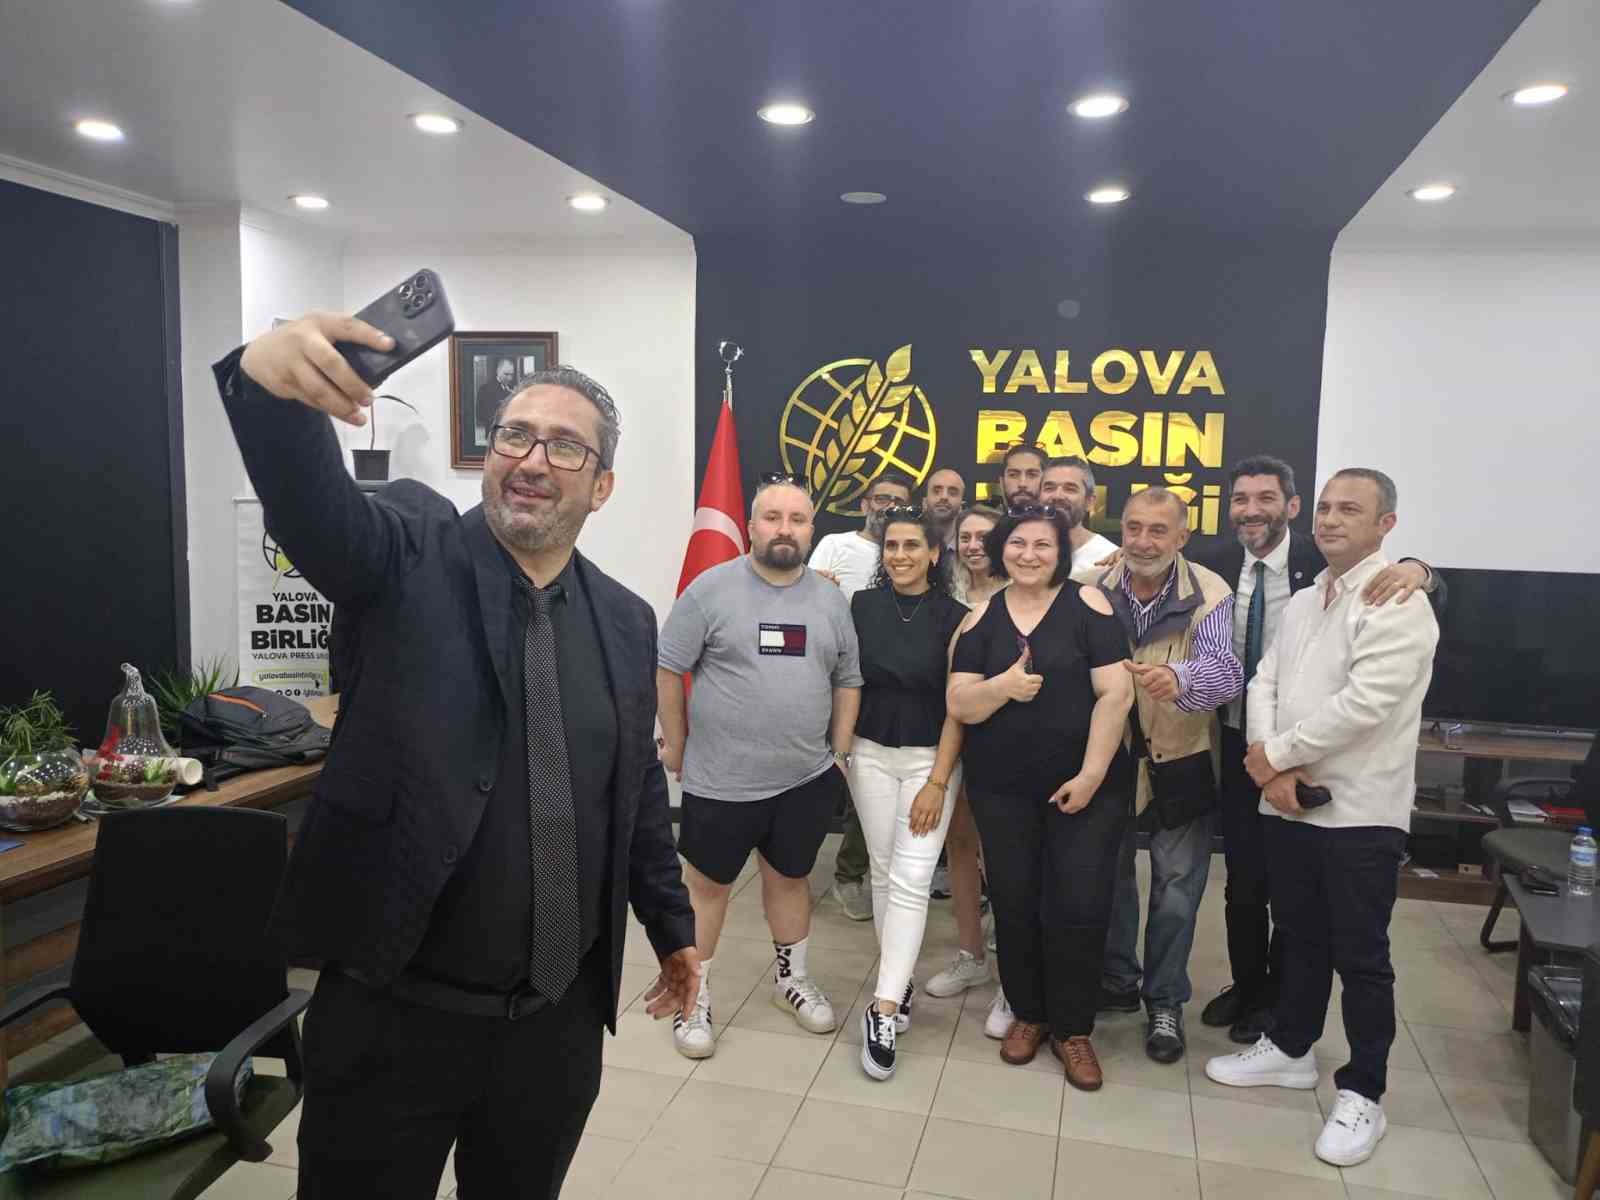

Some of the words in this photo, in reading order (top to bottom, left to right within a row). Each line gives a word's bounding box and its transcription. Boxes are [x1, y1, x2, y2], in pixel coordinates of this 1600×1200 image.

[969, 348, 1225, 395] YALOVA
[975, 409, 1225, 468] BASIN
[272, 592, 318, 602] YALOVA
[256, 604, 330, 624] BASIN
[251, 625, 330, 649] BİRLİĞ
[252, 652, 288, 660] YALOVA
[290, 651, 315, 659] PRESS
